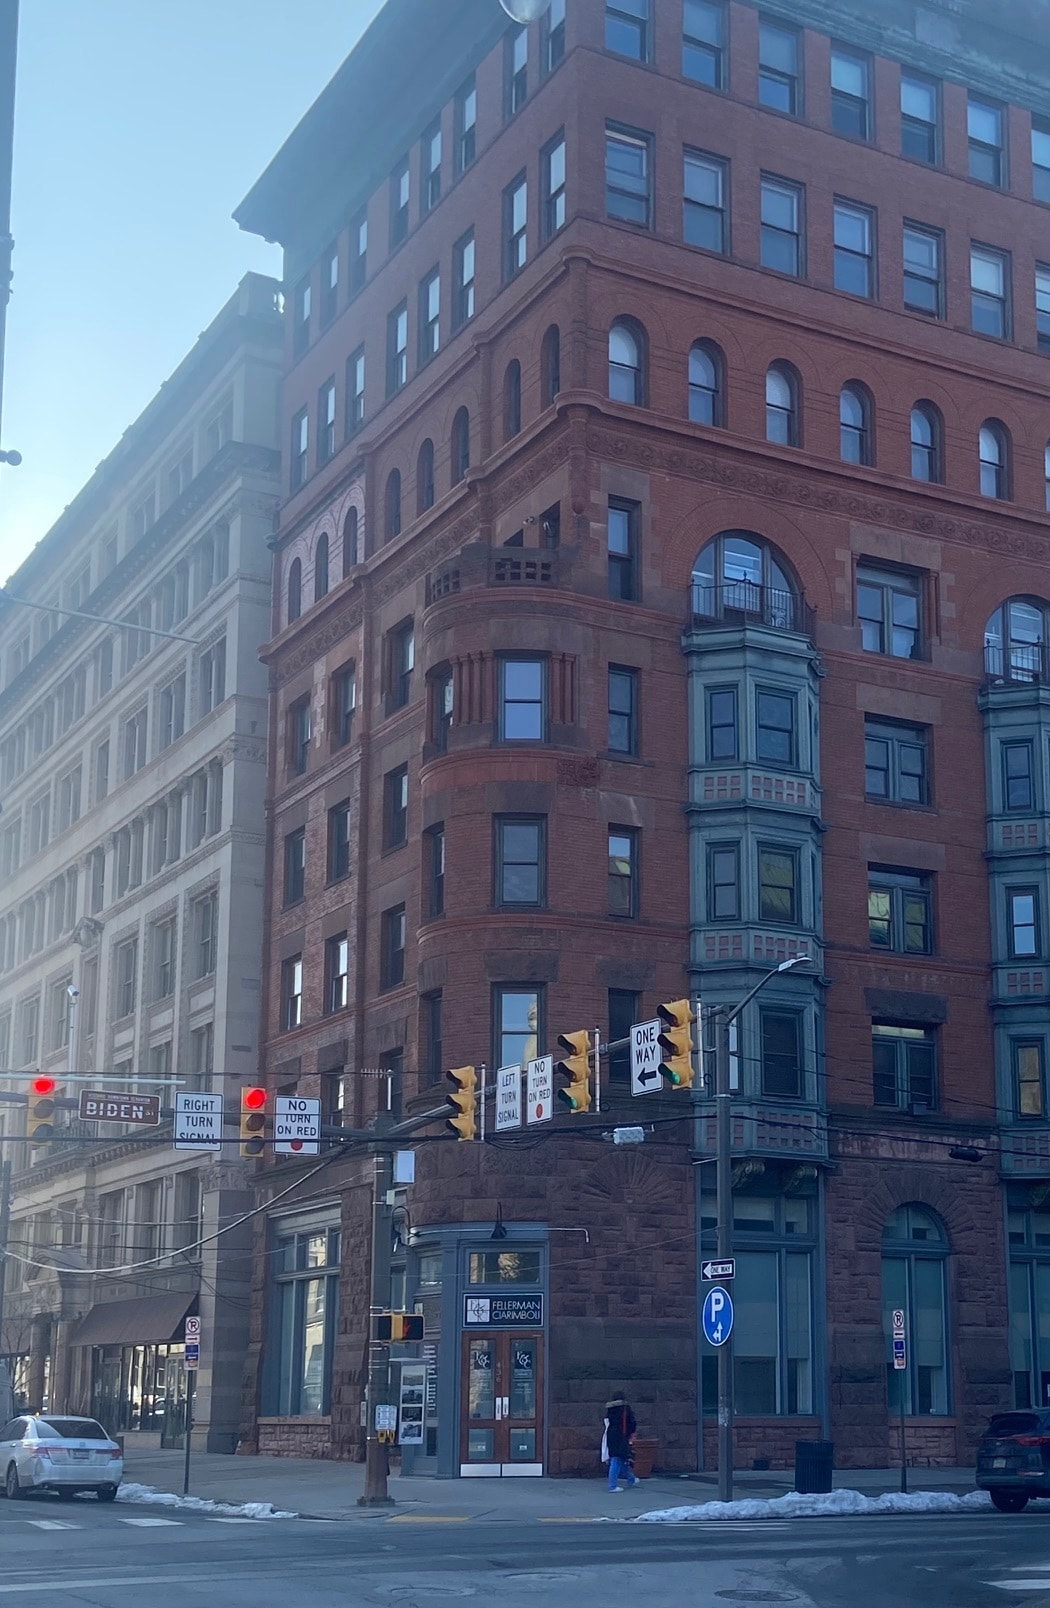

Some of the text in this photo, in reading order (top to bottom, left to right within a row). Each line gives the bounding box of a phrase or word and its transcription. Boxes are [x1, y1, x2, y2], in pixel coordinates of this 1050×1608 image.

[636, 1027, 655, 1045] ONE
[636, 1045, 656, 1064] WAY
[534, 1061, 545, 1074] NO
[502, 1073, 515, 1087] LEFT
[532, 1075, 547, 1088] TURN
[501, 1091, 516, 1104] TURN
[529, 1088, 550, 1103] ON RED
[86, 1101, 143, 1119] BIDEN
[183, 1099, 215, 1111] RIGHT
[288, 1100, 307, 1111] NO
[185, 1116, 213, 1127] TURN
[285, 1114, 311, 1123] TURN
[498, 1108, 518, 1123] SIGNAL
[277, 1125, 317, 1136] ON RED
[179, 1132, 218, 1145] SIGNAL
[721, 1265, 730, 1273] WAY
[492, 1300, 540, 1310] FELLERMAN
[711, 1292, 724, 1322] P
[492, 1310, 540, 1320] CIARIMBOLI
